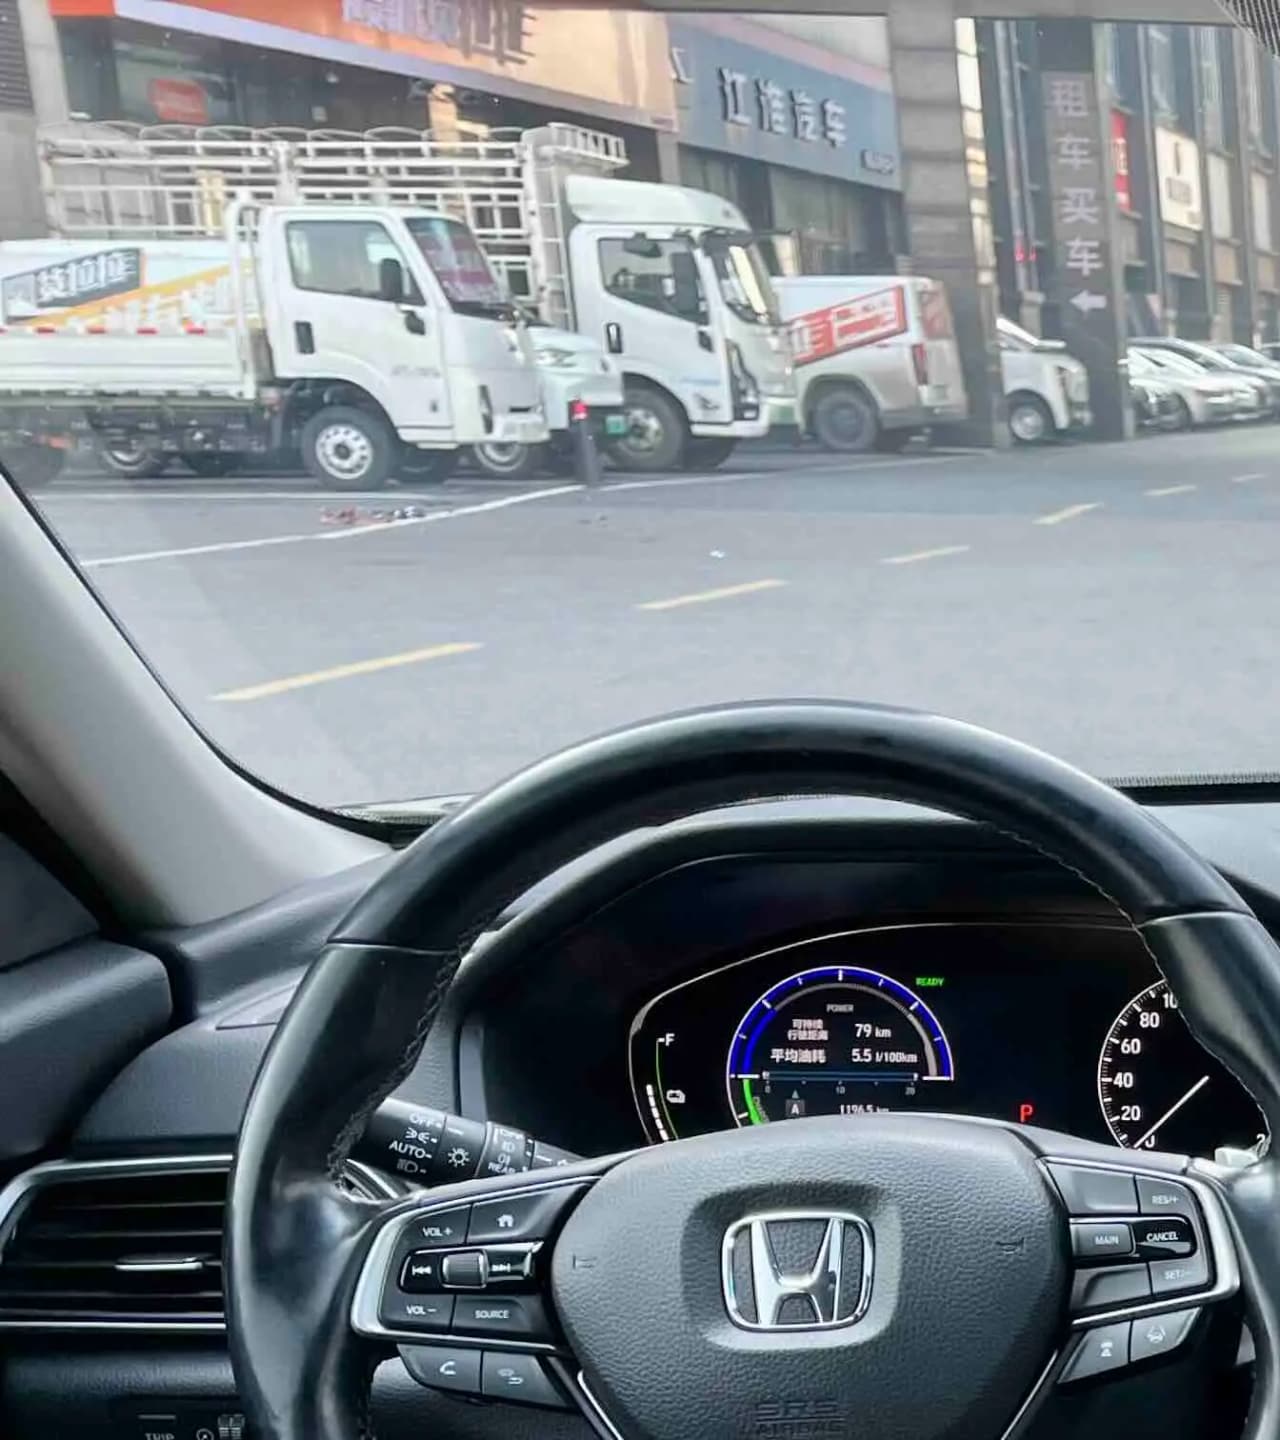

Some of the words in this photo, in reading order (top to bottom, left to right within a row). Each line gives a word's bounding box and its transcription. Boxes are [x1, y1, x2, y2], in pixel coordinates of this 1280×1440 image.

[717, 66, 848, 149] 江淮汽车
[1047, 77, 1103, 277] 租车买车
[826, 1003, 854, 1013] POWER
[1140, 1012, 1160, 1028] 80
[855, 1023, 873, 1038] 79
[875, 1026, 892, 1038] km
[665, 1033, 675, 1046] F
[1120, 1038, 1142, 1054] 60
[851, 1048, 872, 1063] 5.5
[1113, 1072, 1133, 1088] 40
[1020, 1104, 1033, 1122] P
[1120, 1105, 1142, 1121] 20
[389, 1140, 426, 1159] AUTO
[1095, 1235, 1119, 1245] MAIN
[1146, 1231, 1179, 1242] CANCEL
[475, 1309, 509, 1319] SOURCE
